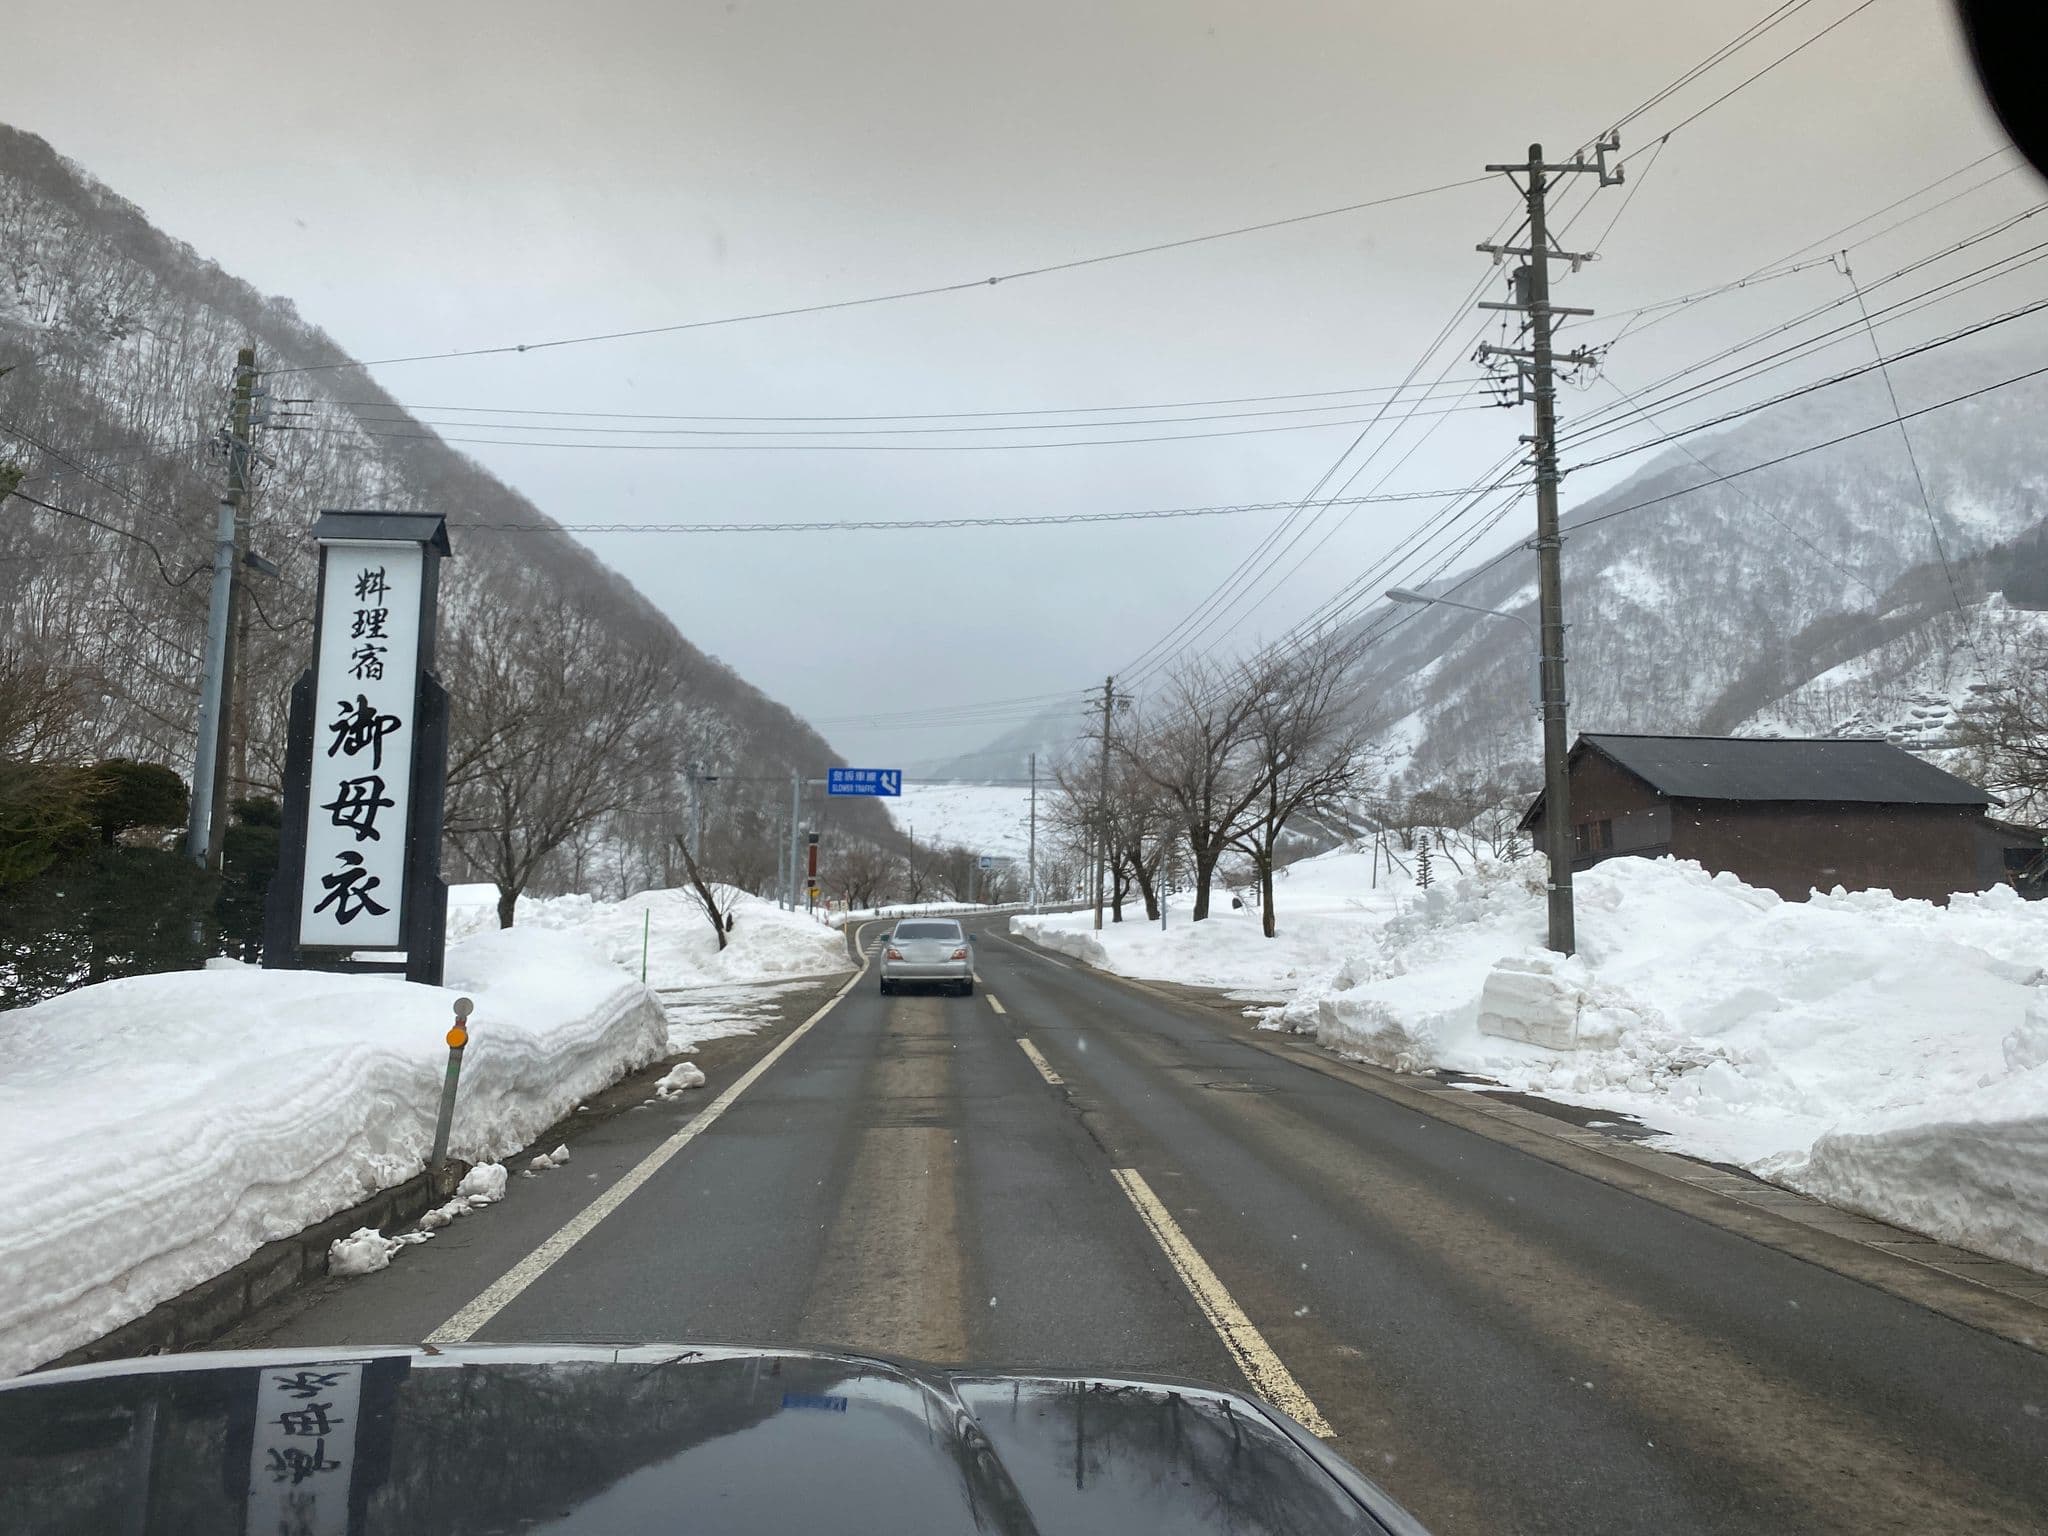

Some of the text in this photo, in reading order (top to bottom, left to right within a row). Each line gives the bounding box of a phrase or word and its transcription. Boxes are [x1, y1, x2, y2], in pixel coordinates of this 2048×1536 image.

[313, 566, 402, 925] 料理宿 御母衣
[832, 783, 877, 793] SLOWER TRAFFIC
